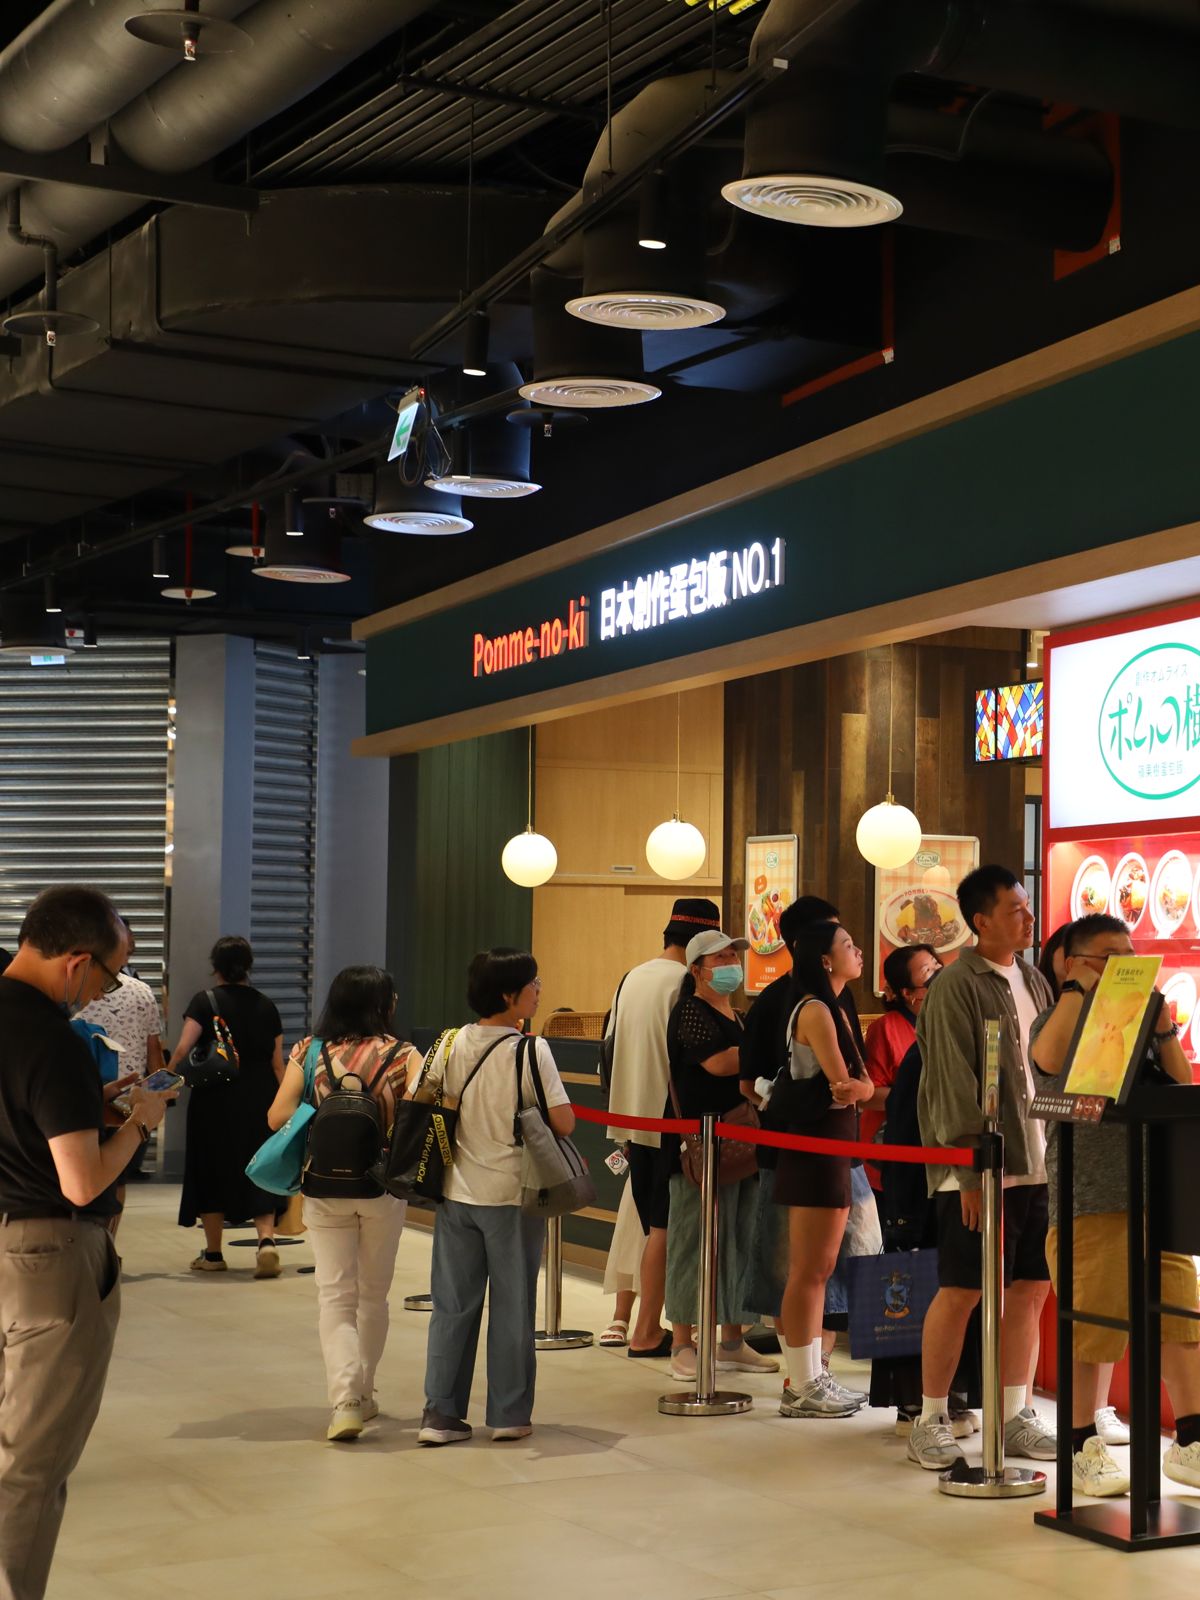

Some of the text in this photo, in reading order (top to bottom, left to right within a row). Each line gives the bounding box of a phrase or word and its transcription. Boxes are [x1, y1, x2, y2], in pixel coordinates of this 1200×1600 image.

[599, 536, 783, 642] 日本創作蛋包飯 NO.1
[473, 595, 588, 678] Pomme-no-ki
